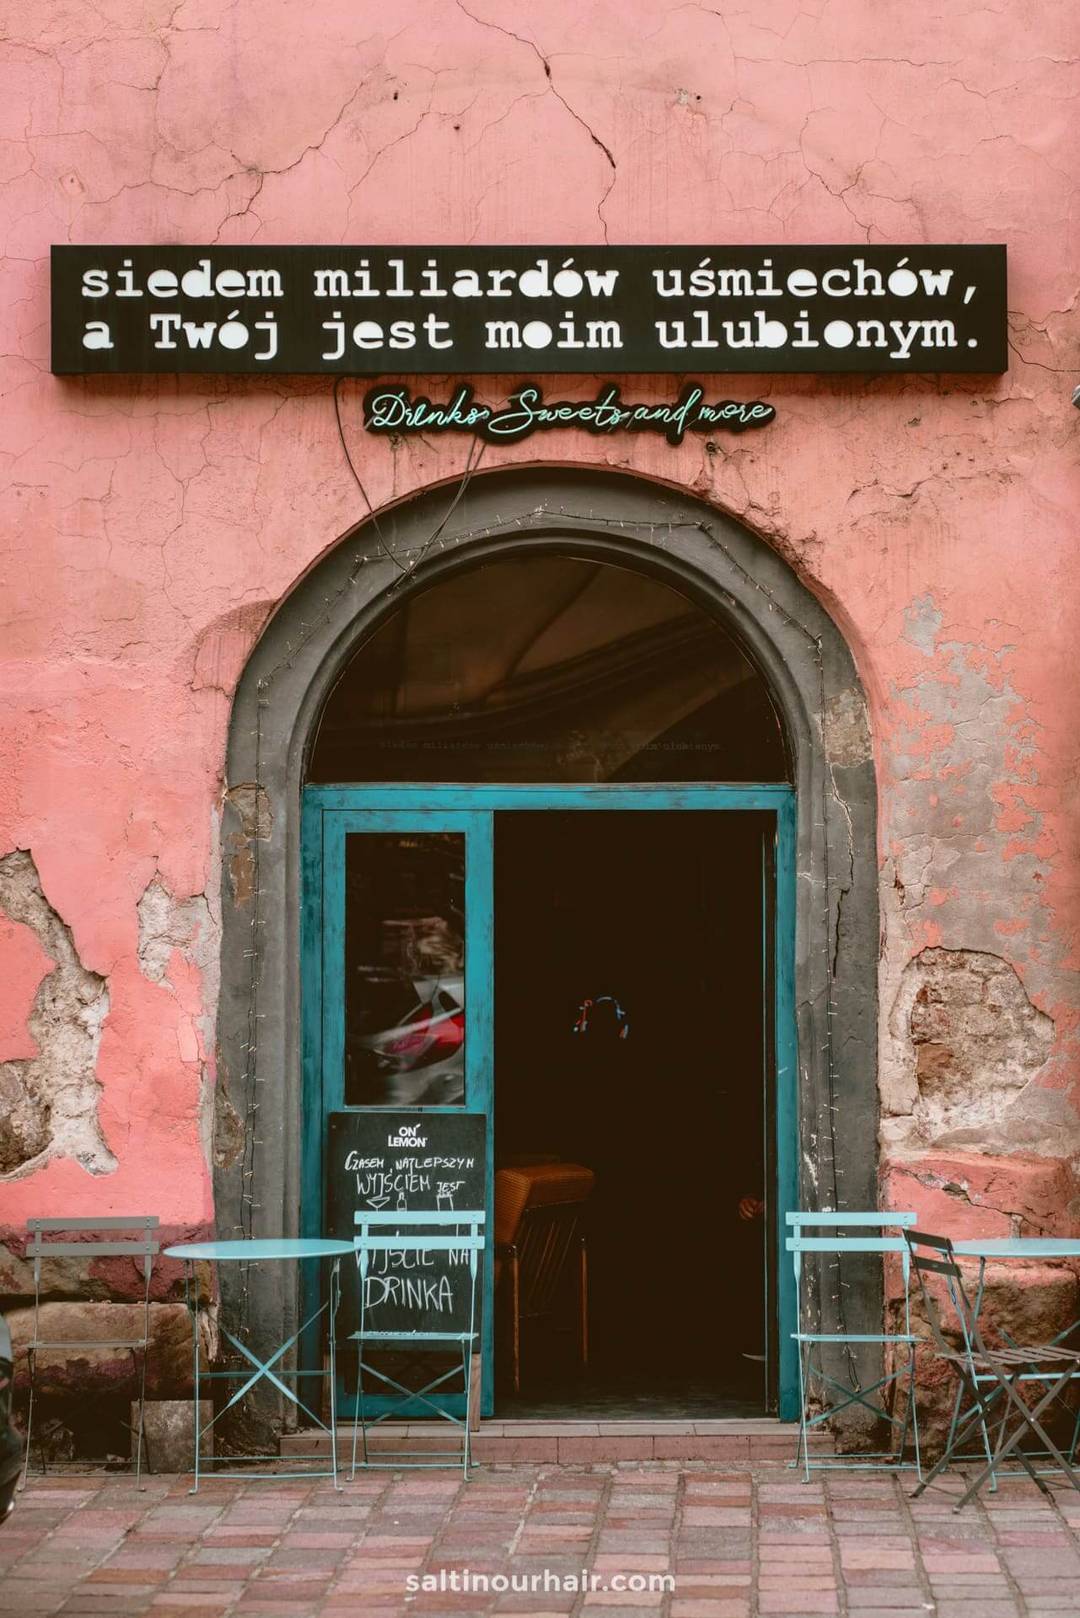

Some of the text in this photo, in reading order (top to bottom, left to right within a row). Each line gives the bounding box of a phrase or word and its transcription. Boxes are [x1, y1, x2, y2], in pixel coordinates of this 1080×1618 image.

[82, 257, 977, 305] siedem miliardów uśmiechów,
[82, 309, 978, 361] a Twój jest moim ulubionym.
[488, 389, 627, 434] Sweets
[634, 388, 702, 435] and
[698, 403, 773, 423] more
[436, 1181, 466, 1193] JEST
[364, 1275, 454, 1315] DRINKA
